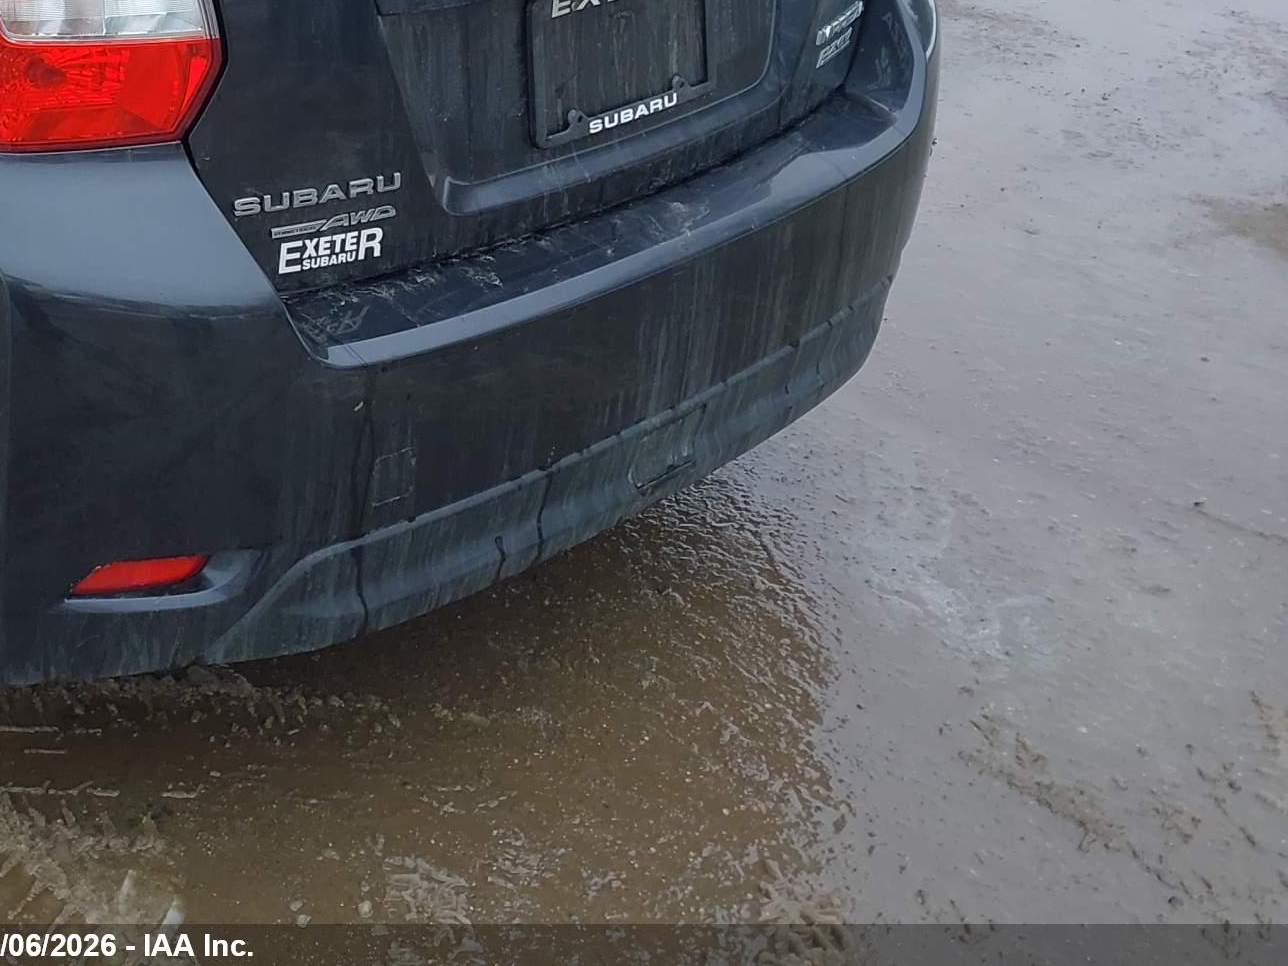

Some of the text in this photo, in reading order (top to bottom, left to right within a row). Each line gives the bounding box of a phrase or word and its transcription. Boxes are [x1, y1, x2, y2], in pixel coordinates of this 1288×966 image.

[588, 92, 678, 135] SUBARU
[233, 171, 402, 217] SUBARU
[319, 204, 397, 232] AWD
[278, 227, 384, 275] EXETER
[301, 251, 357, 271] SUBARU
